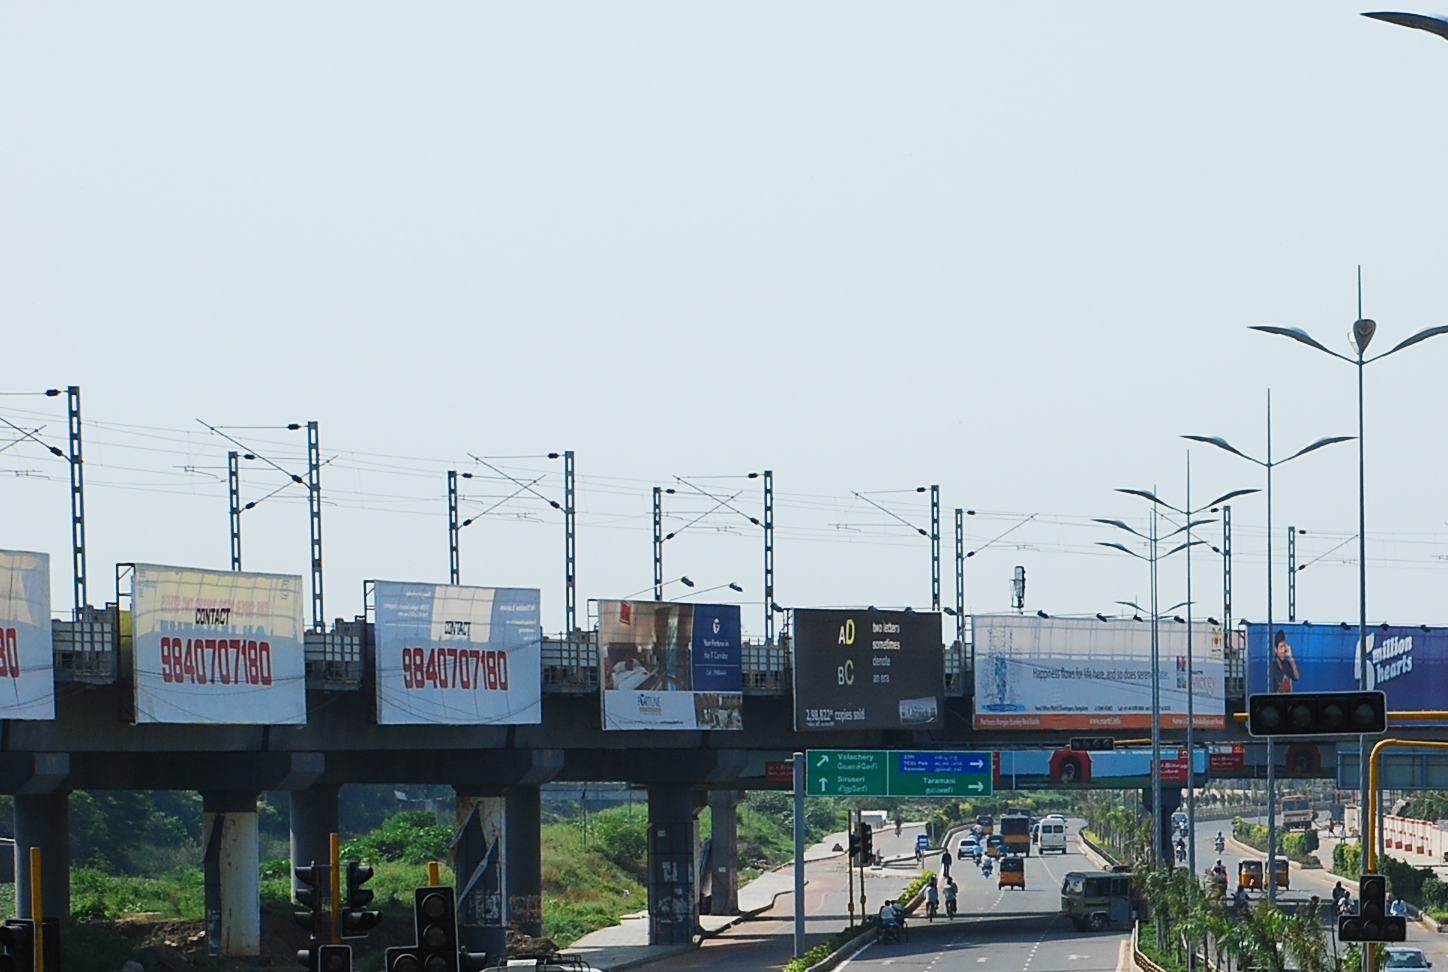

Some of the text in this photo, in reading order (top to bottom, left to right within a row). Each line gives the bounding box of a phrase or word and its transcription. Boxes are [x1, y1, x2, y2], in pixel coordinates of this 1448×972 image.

[195, 608, 231, 625] CONTACT
[444, 621, 471, 636] CONTACT
[838, 619, 855, 645] AD
[872, 621, 900, 633] two letters
[872, 639, 900, 650] sometimes
[1372, 635, 1413, 664] million
[161, 636, 273, 686] 9840707180
[402, 647, 509, 691] 9840707180
[1376, 655, 1413, 684] hearts
[838, 659, 854, 685] BC
[1032, 667, 1060, 681] Happiness
[834, 708, 853, 723] copies
[853, 708, 865, 721] sold
[837, 775, 865, 783] Siruseri
